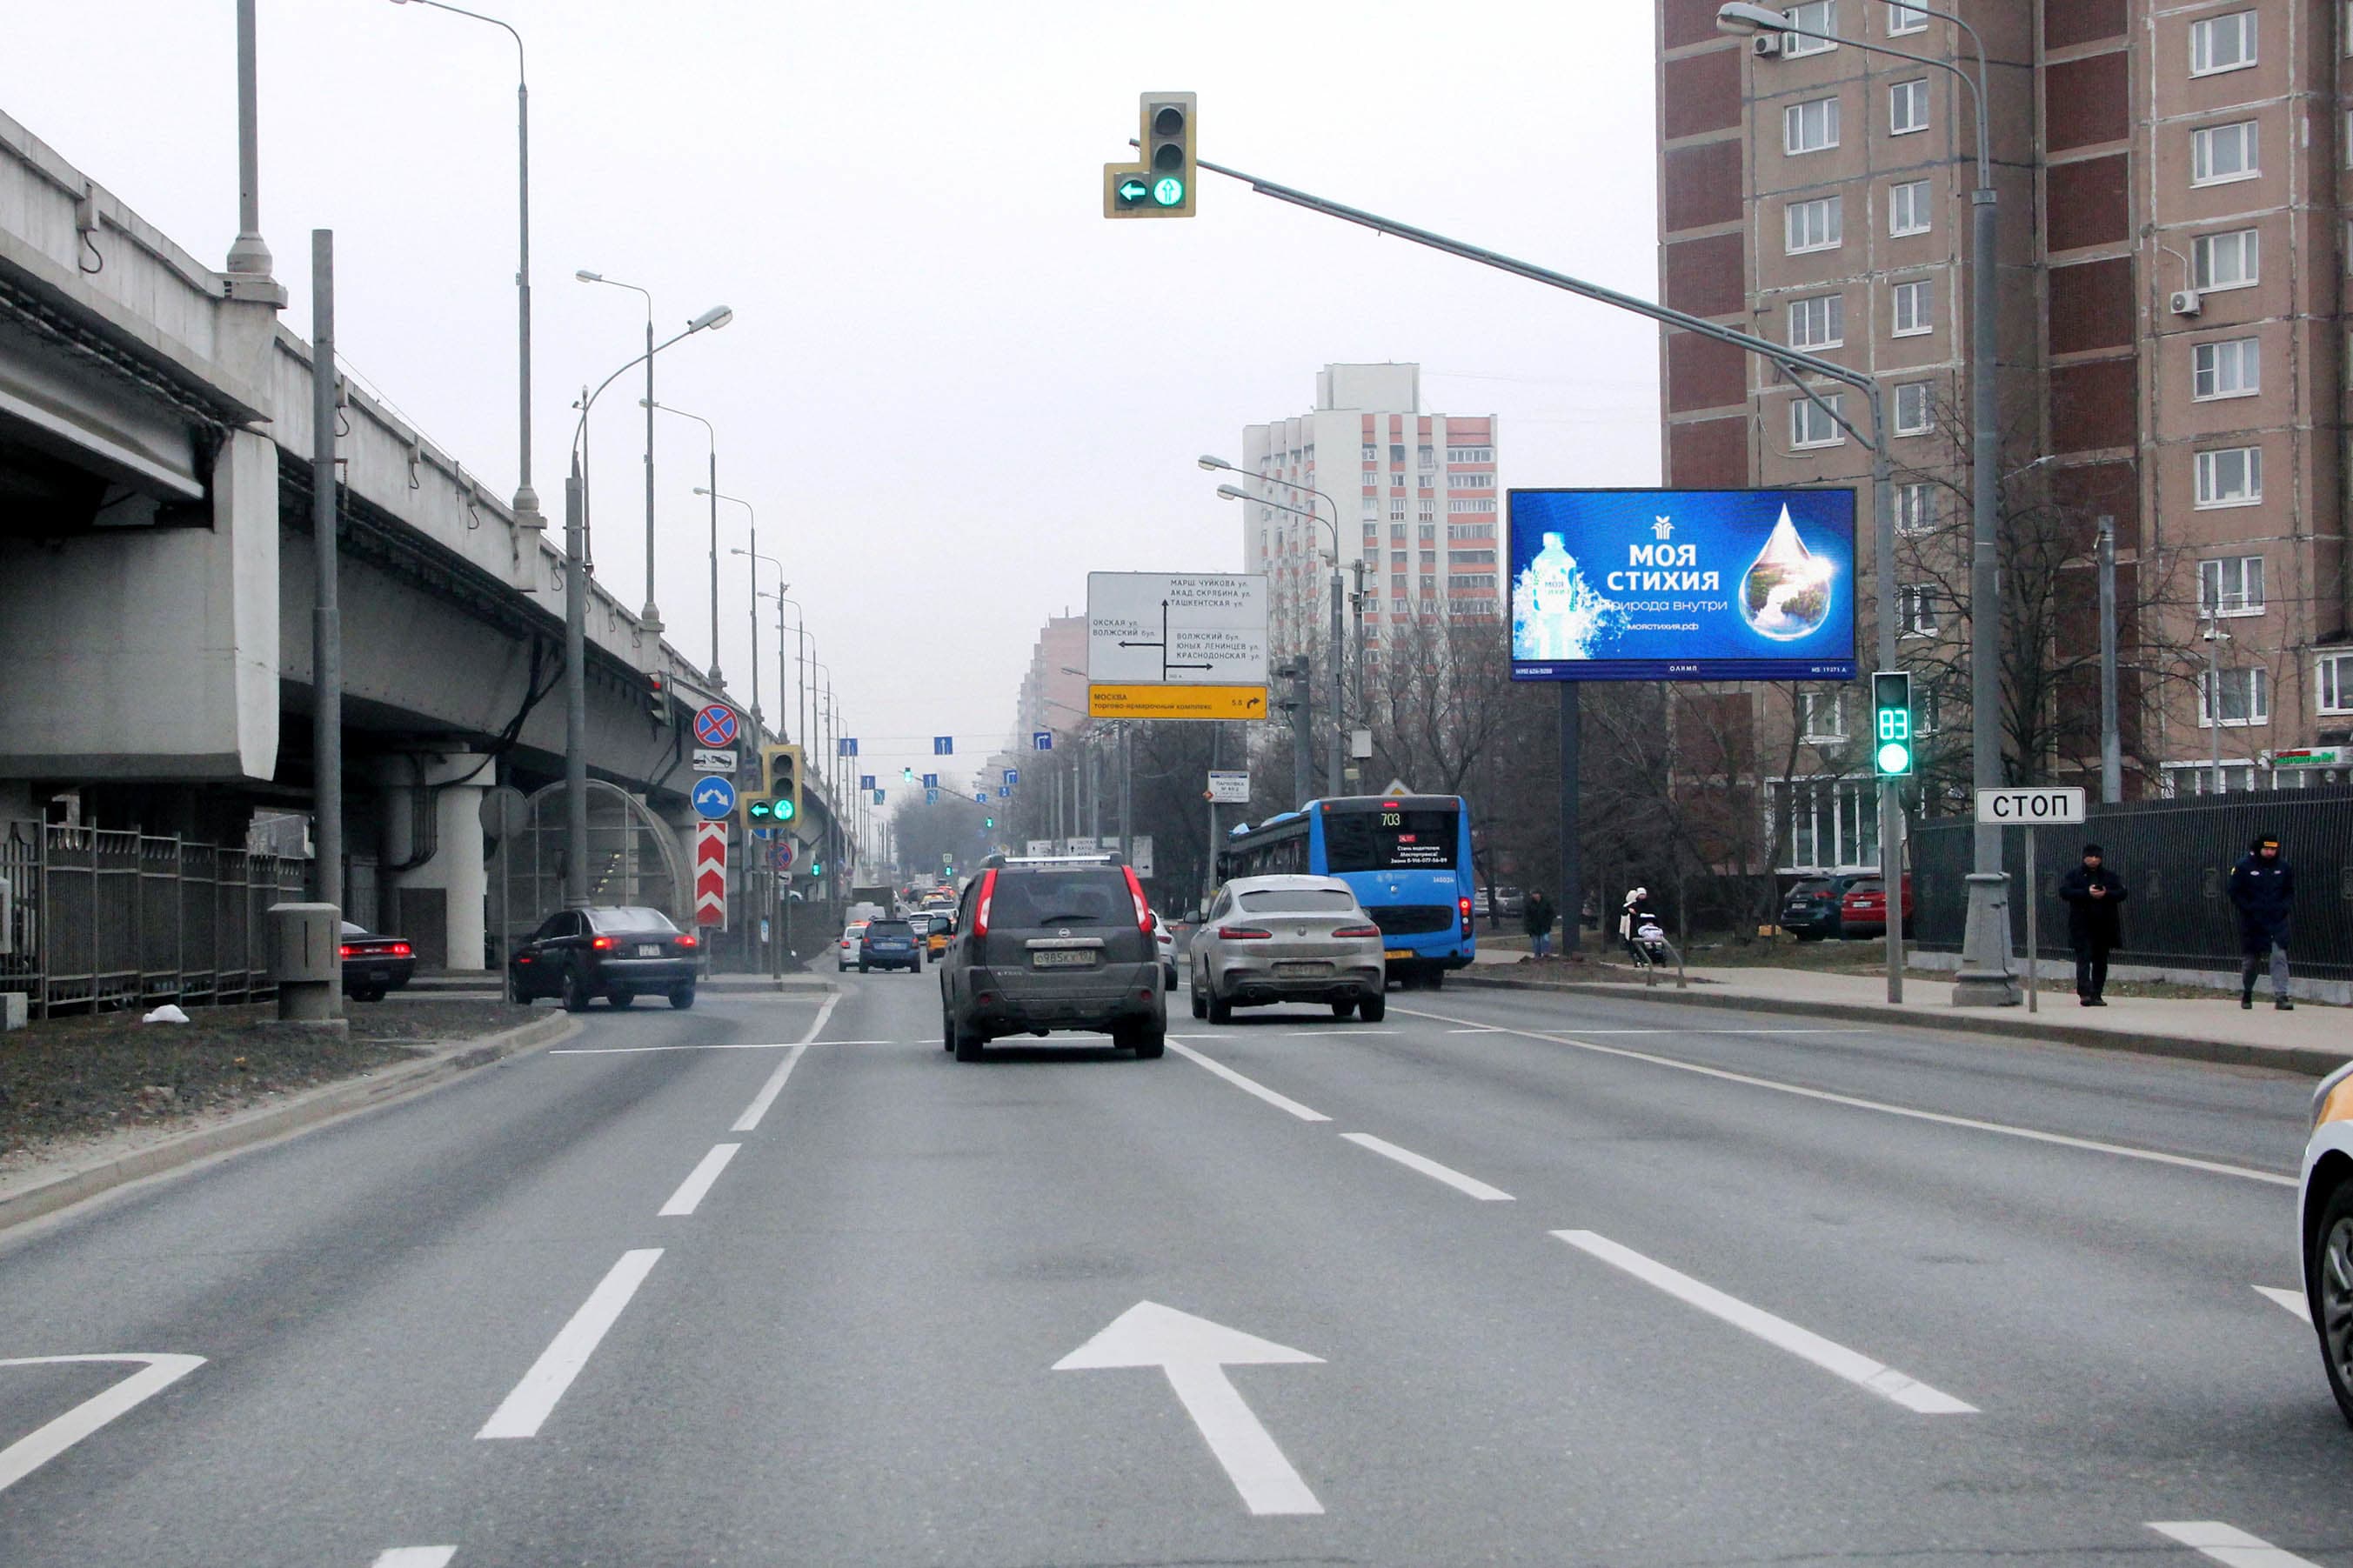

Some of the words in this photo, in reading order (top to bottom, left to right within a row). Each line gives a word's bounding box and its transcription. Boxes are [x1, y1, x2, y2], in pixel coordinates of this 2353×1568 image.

[1629, 544, 1696, 567] МОЯ
[1199, 578, 1235, 587] ЧУЙКОВА
[1607, 570, 1720, 591] СТИХИЯ
[1673, 600, 1728, 613] внутри
[1093, 628, 1139, 637] ВОЛЖСКИЙ
[1879, 710, 1908, 740] 83
[1992, 794, 2069, 817] СТОП
[1380, 812, 1400, 826] 703
